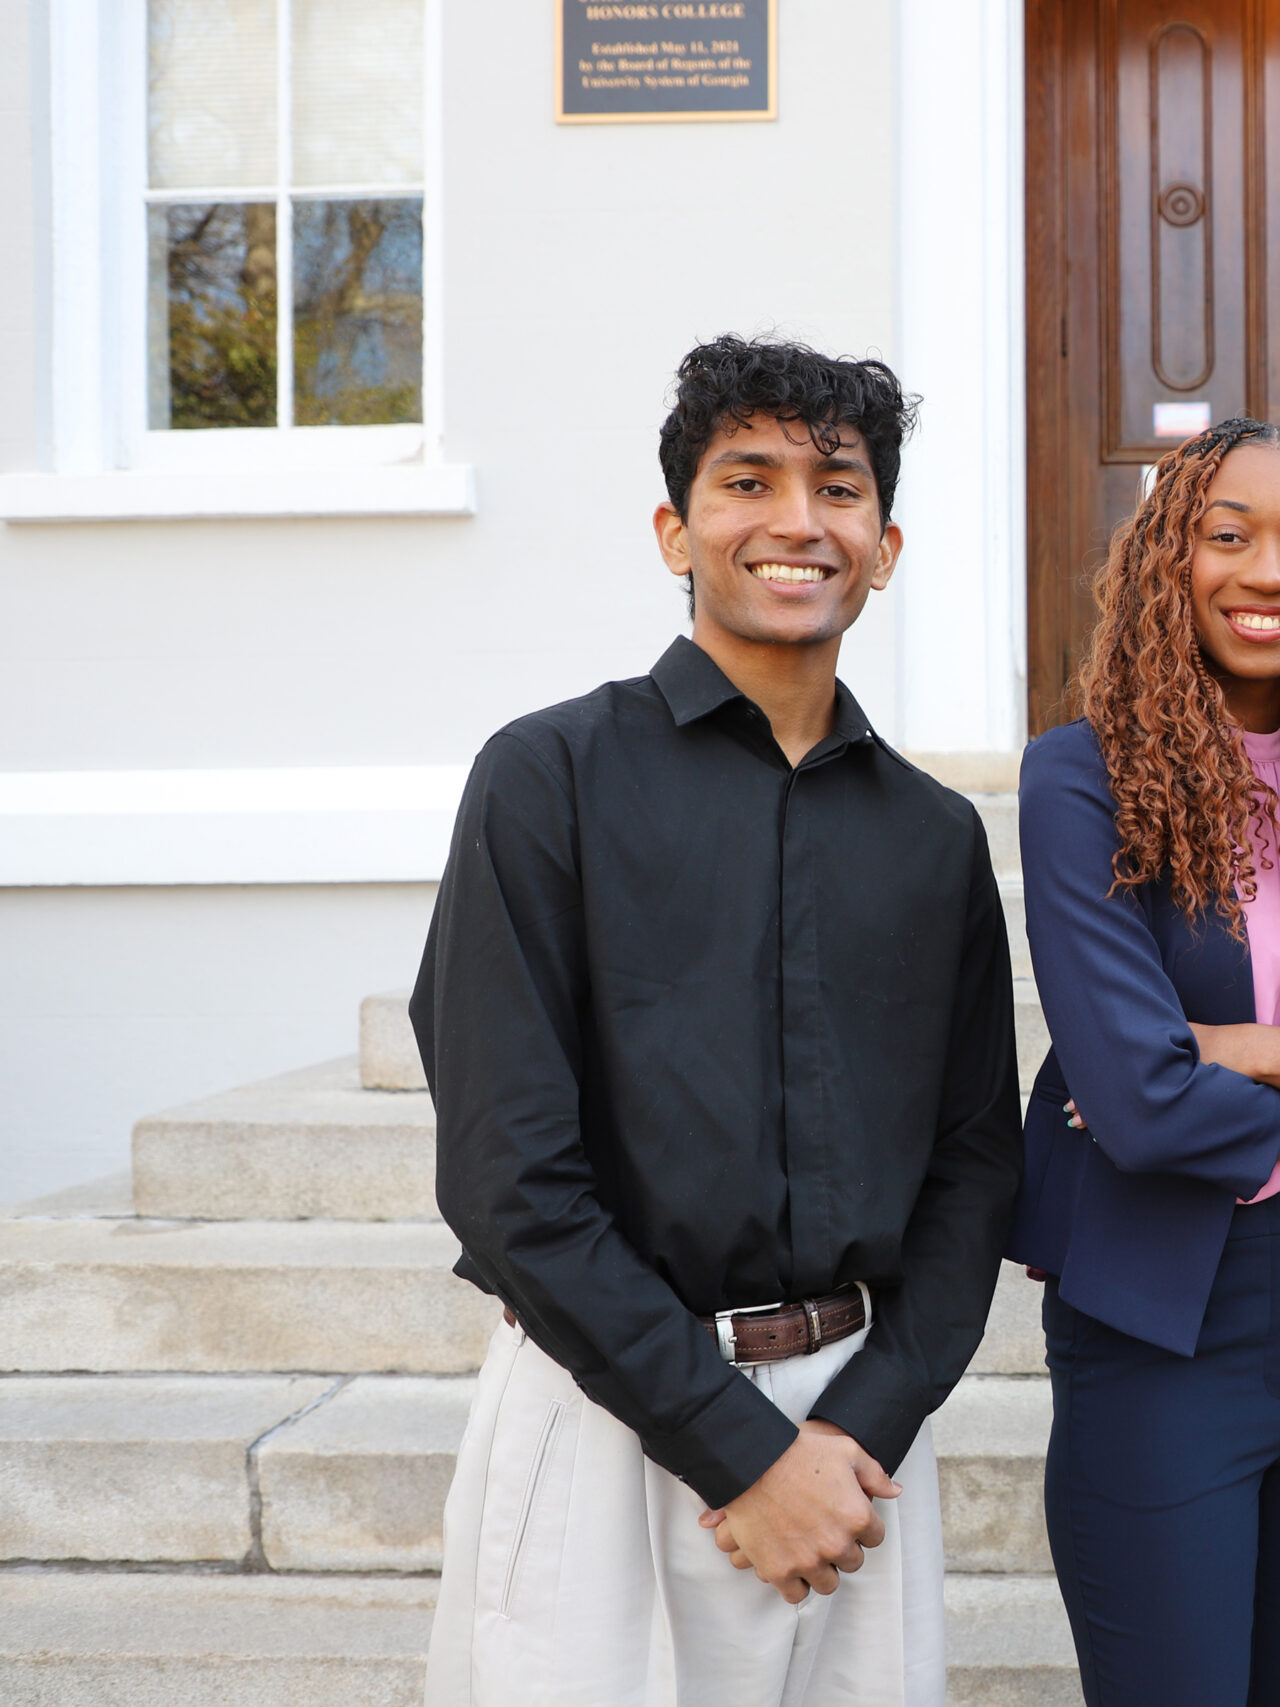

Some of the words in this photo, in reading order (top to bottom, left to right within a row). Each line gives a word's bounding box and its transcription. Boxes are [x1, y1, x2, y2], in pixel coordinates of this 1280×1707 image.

[587, 4, 658, 20] HONORS
[662, 3, 744, 19] COLLEGE
[592, 41, 658, 55] Established
[661, 41, 686, 56] May
[579, 59, 593, 72] by
[597, 59, 614, 71] the
[618, 59, 654, 71] Board
[656, 58, 669, 70] of
[671, 58, 716, 71] Regents
[718, 57, 731, 69] of
[733, 57, 751, 69] the
[582, 76, 640, 89] University
[644, 75, 685, 89] System
[687, 75, 700, 86] of
[702, 74, 749, 88] Georgia
